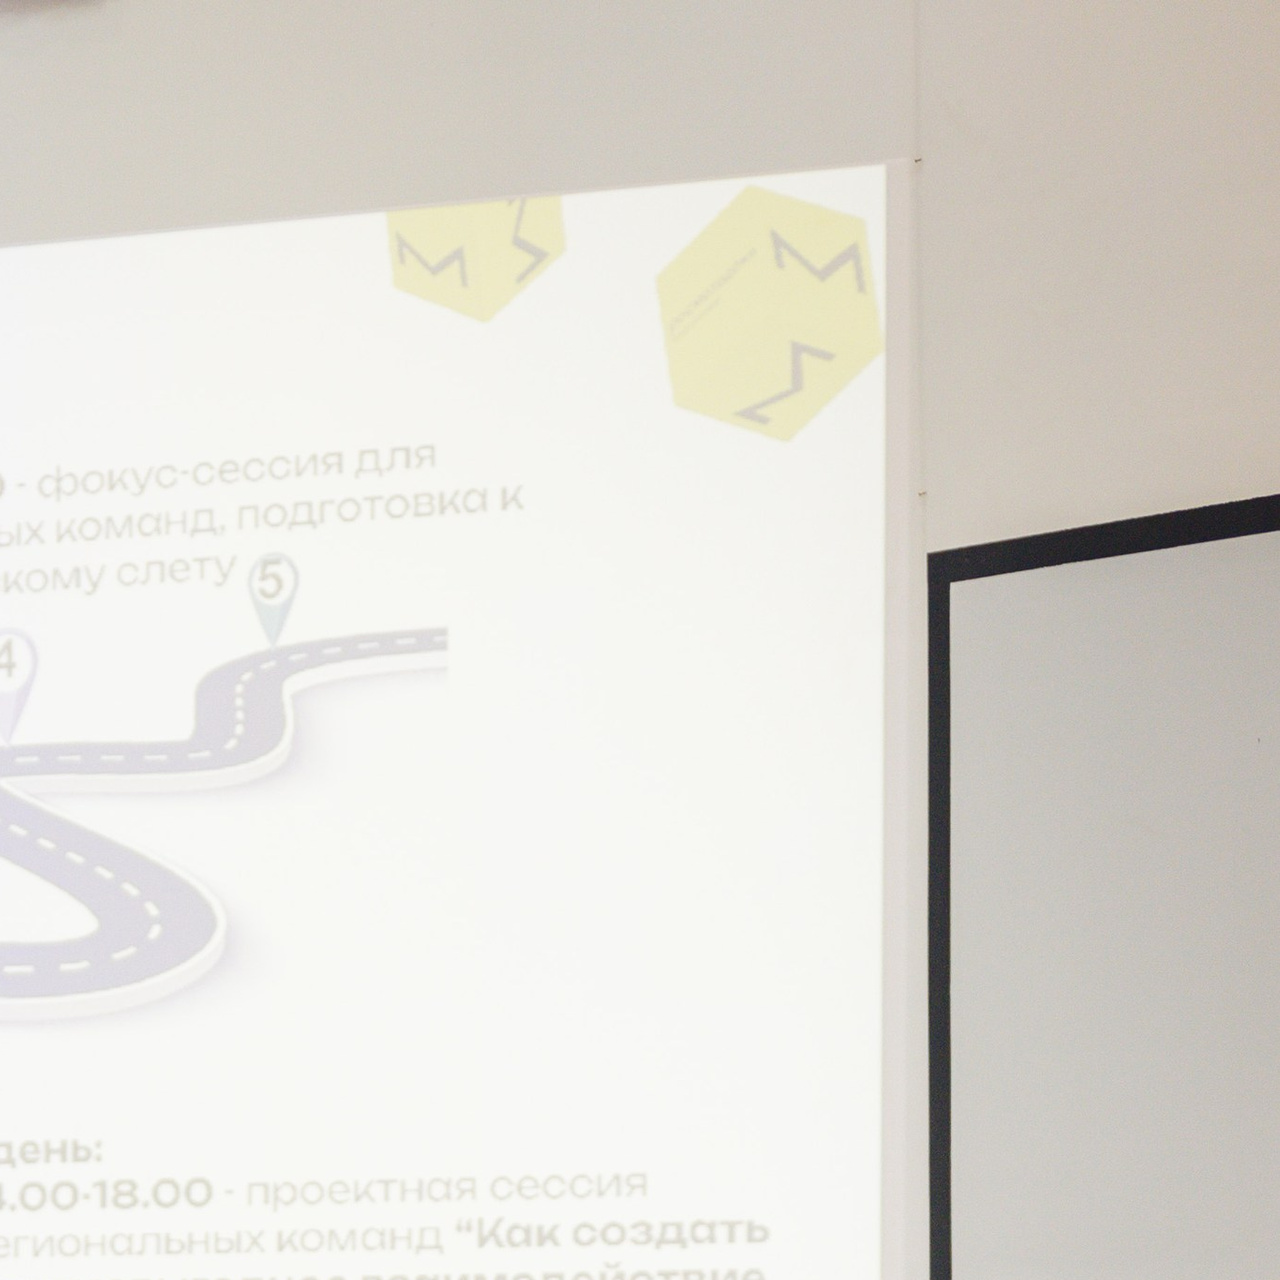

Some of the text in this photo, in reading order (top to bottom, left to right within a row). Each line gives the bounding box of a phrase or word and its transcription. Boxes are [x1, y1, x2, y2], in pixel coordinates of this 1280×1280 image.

[37, 451, 345, 506] фокус-сессия
[354, 442, 436, 479] для
[55, 502, 228, 547] команд,
[236, 486, 489, 538] подготовка
[499, 487, 525, 512] к
[115, 551, 237, 592] слету
[257, 560, 284, 600] 5
[246, 1174, 477, 1213] проектная
[489, 1171, 648, 1201] сессия
[276, 1223, 445, 1256] команд
[571, 1215, 770, 1251] создать
